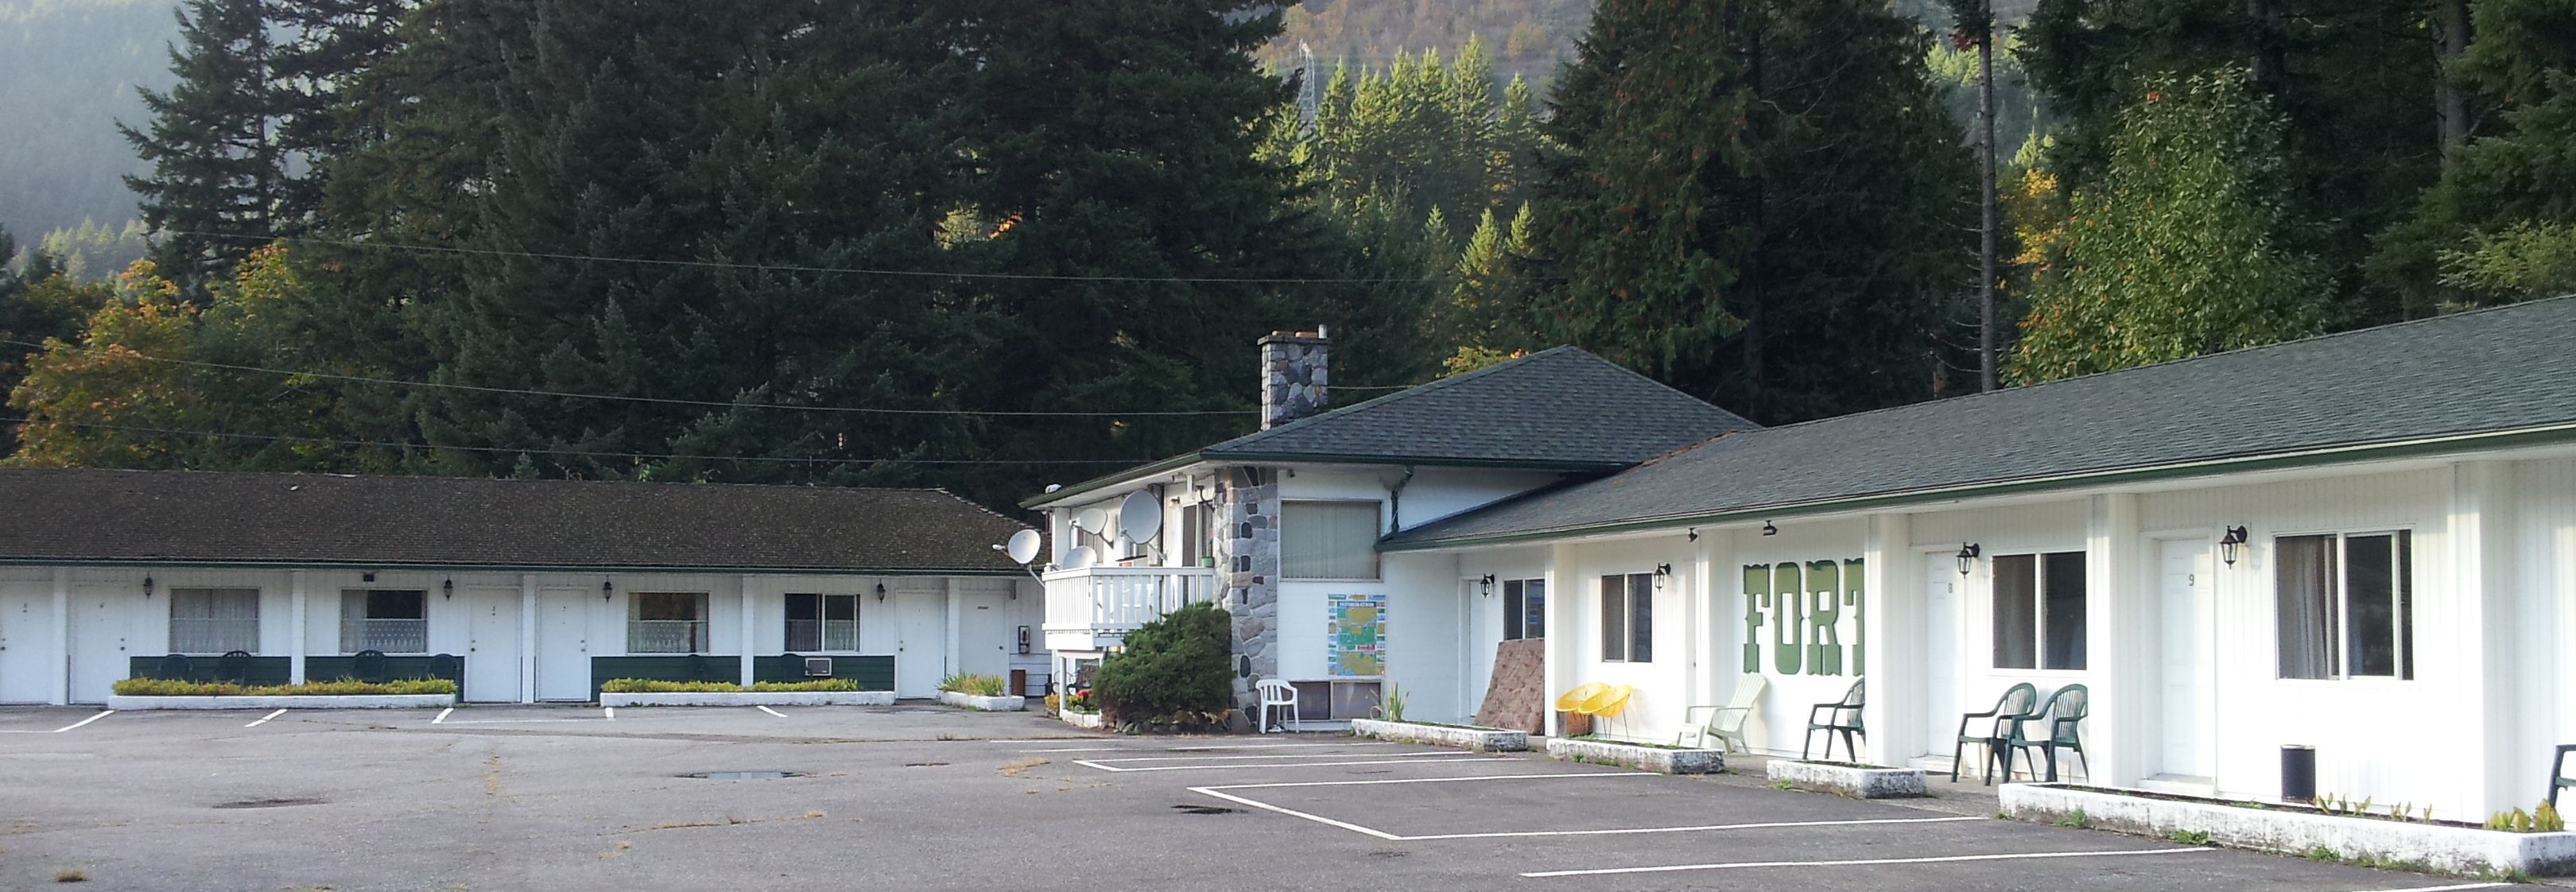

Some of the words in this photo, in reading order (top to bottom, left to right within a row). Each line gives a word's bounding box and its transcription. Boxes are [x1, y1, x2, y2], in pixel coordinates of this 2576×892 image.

[2189, 573, 2194, 587] 9
[1948, 582, 1953, 593] 8
[1743, 557, 1864, 677] FORT
